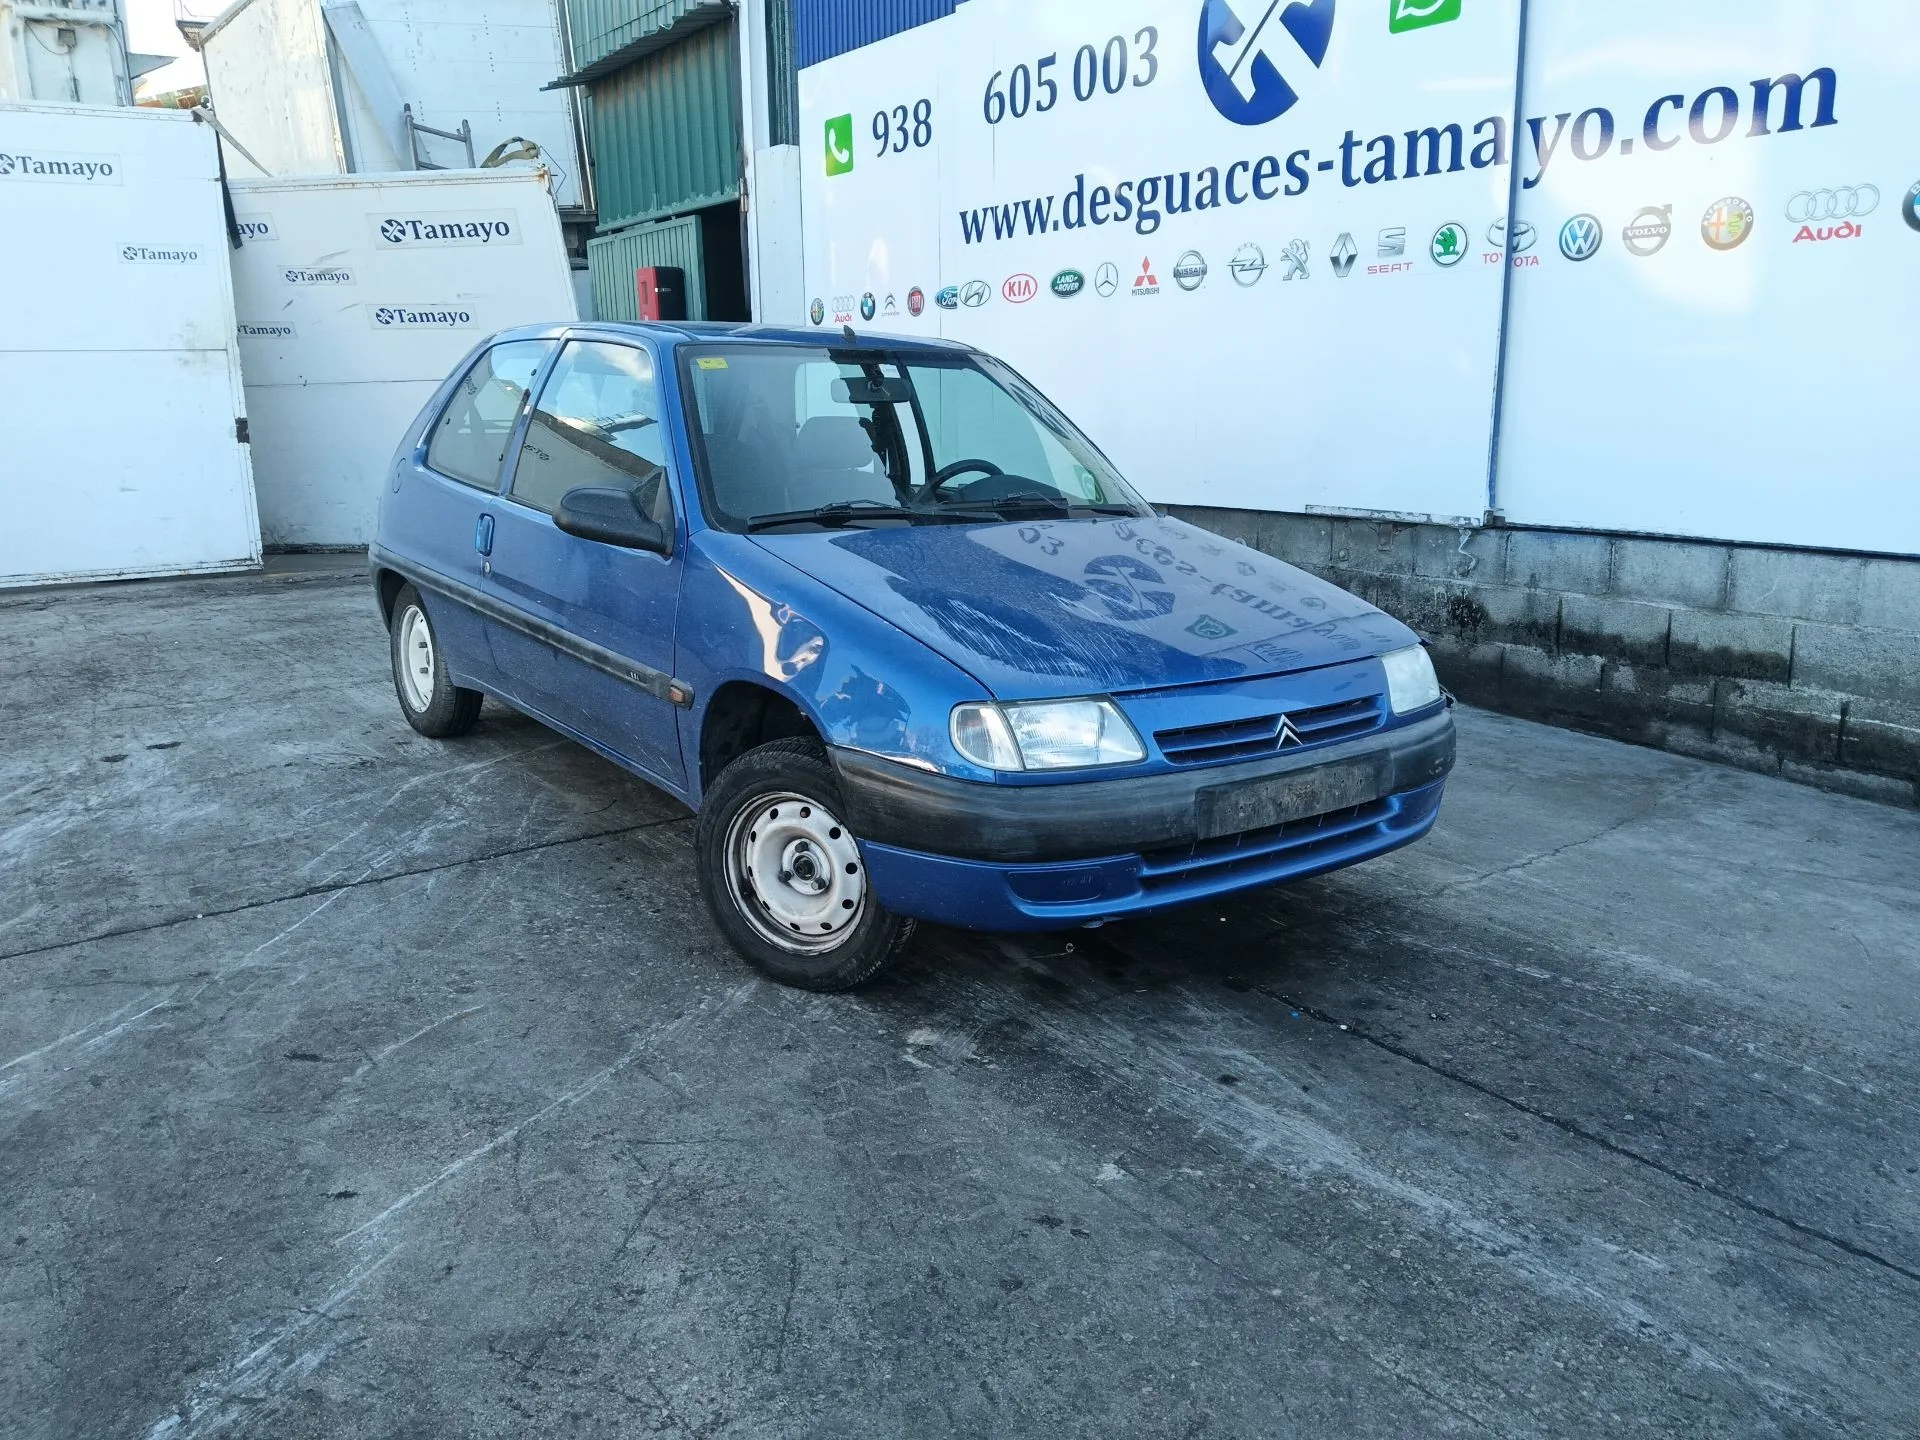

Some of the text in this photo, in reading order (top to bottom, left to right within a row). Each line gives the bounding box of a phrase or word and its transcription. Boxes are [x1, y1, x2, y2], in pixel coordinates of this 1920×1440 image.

[872, 25, 1158, 157] 938 605 003
[960, 66, 1838, 244] www.desguaces-tamayo.com
[16, 155, 113, 180] Tamayo
[237, 223, 268, 238] ayo
[405, 220, 510, 244] Tamayo
[1626, 226, 1668, 238] VOLVO
[1792, 220, 1862, 243] Audi
[138, 248, 198, 263] Tamayo
[1176, 267, 1203, 276] NISSAN
[1367, 262, 1413, 274] SEAT
[298, 271, 350, 283] Tamayo
[1056, 274, 1074, 284] LAND
[1008, 280, 1032, 297] KIA
[1057, 282, 1079, 292] ROVER
[1131, 288, 1160, 296] MITSUBISHI
[942, 291, 958, 306] For
[394, 309, 470, 327] Tamayo
[240, 325, 291, 337] Tamayo
